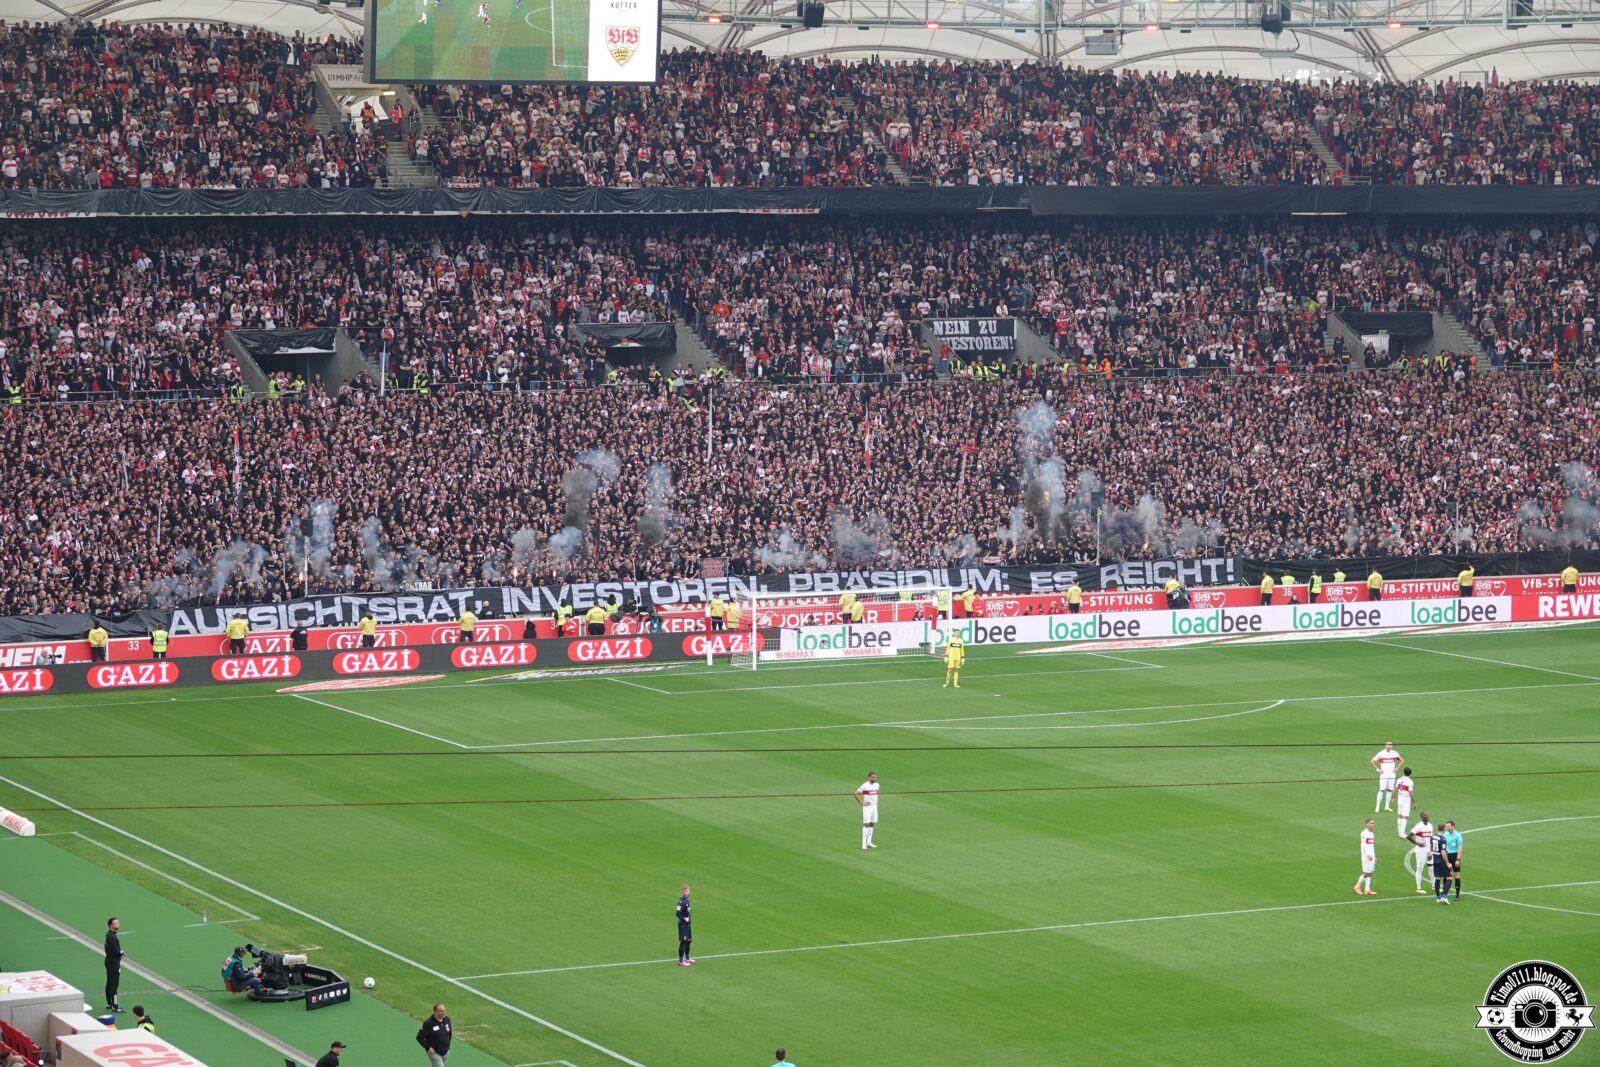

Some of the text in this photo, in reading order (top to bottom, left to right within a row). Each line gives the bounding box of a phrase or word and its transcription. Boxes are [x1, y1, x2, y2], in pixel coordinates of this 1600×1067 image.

[933, 320, 997, 336] NEIN ZU
[1029, 571, 1078, 593] ES
[1100, 558, 1235, 589] REICHT!
[1283, 587, 1292, 597] 36
[915, 603, 925, 612] 35
[1293, 604, 1381, 629] loadbee
[1411, 599, 1497, 624] loadbee
[1049, 614, 1140, 640] loadbee
[1172, 609, 1262, 635] loadbee
[128, 641, 139, 650] 33
[797, 625, 892, 650] loadbee
[775, 651, 815, 659] WINAMAX
[843, 648, 883, 656] WINAMAX
